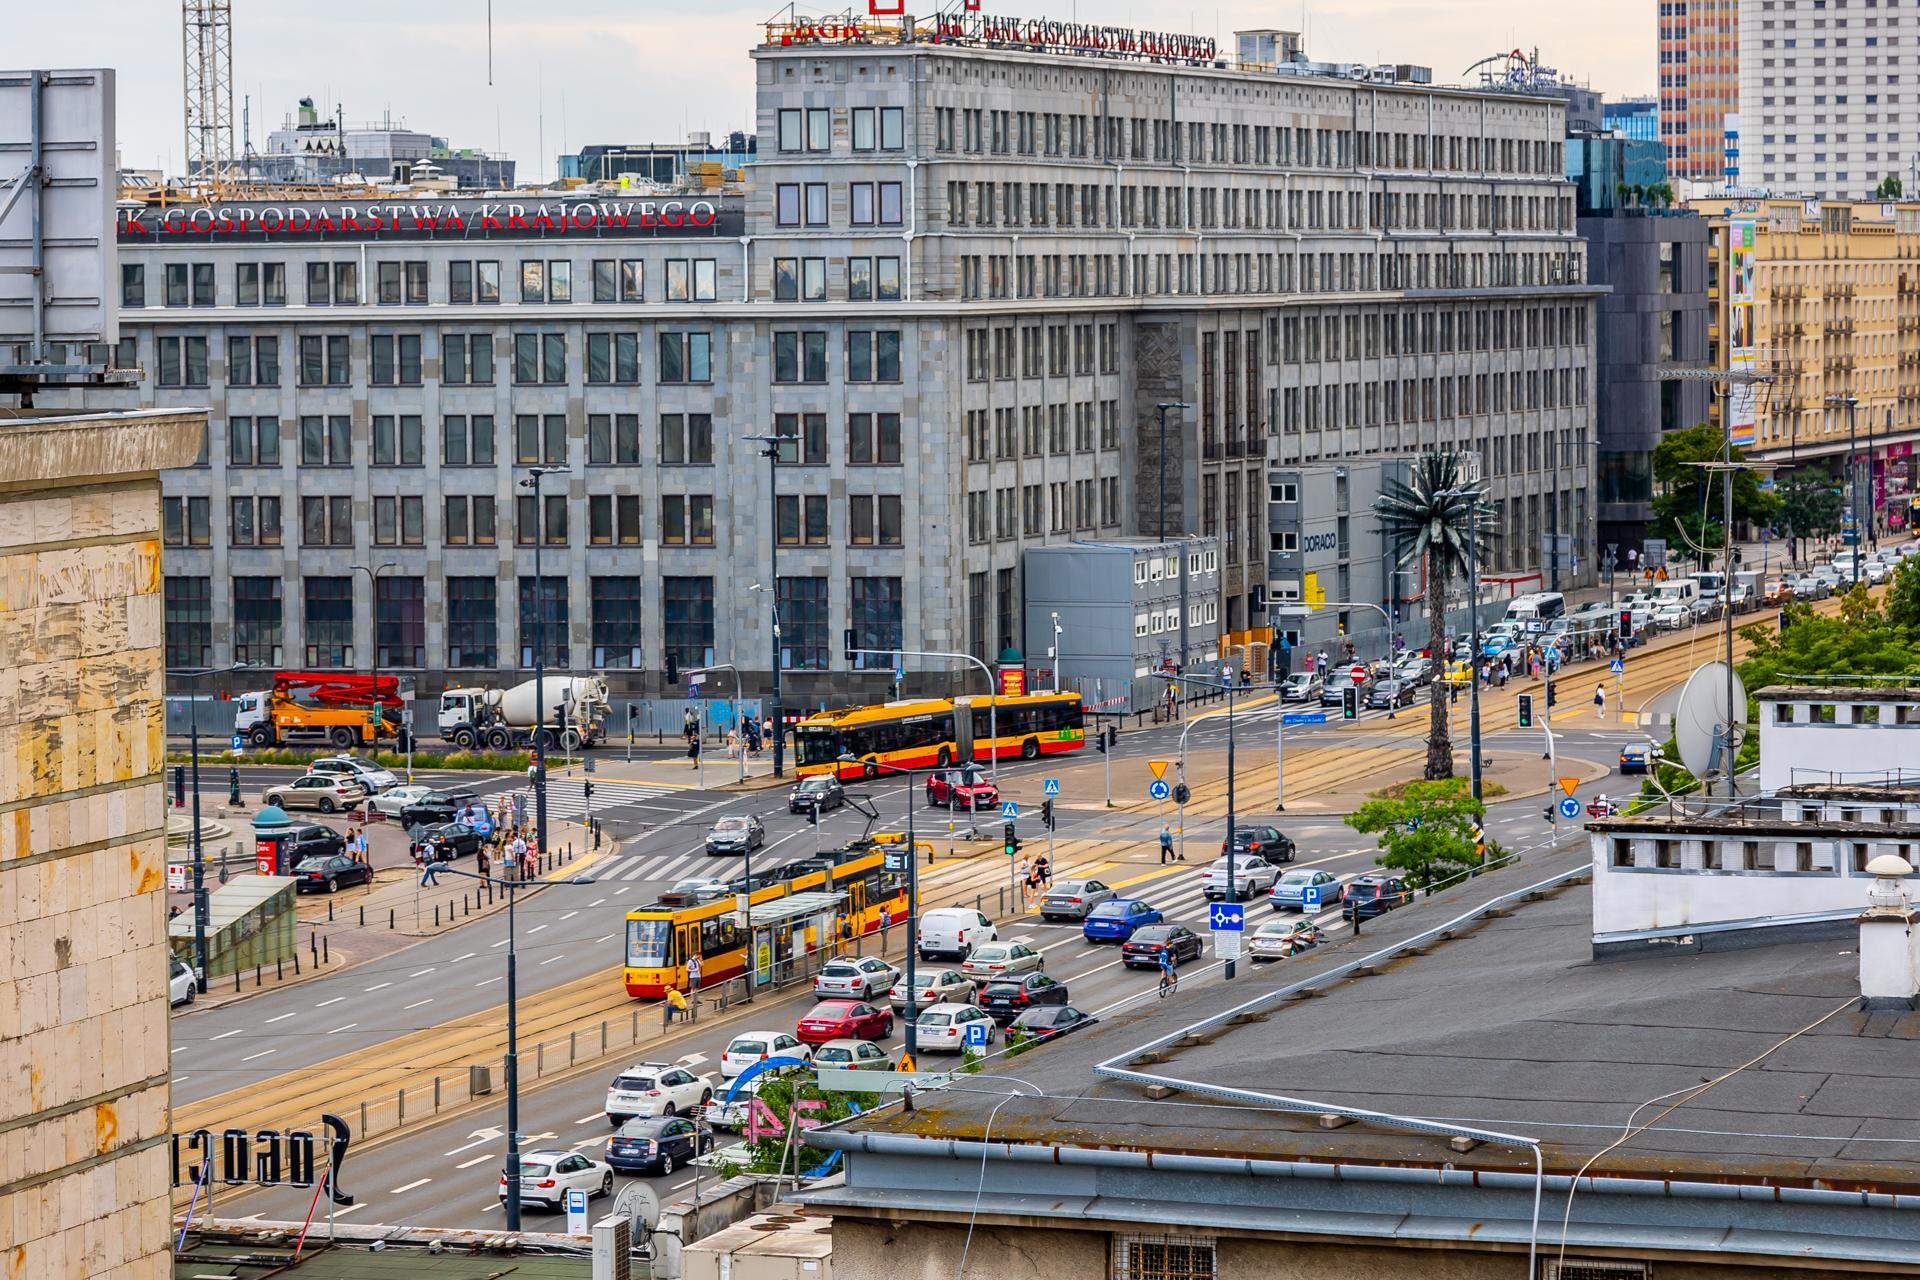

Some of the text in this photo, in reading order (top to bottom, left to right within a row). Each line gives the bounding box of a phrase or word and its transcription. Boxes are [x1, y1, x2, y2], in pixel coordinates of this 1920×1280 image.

[794, 15, 863, 39] BGK
[982, 14, 1023, 42] BANK
[1139, 30, 1216, 59] KRAJOWEGO
[116, 200, 717, 234] K GOSPODARSTWA KRAJOWEGO
[1304, 532, 1337, 553] DORACO
[1306, 888, 1317, 903] P
[970, 1026, 982, 1044] P
